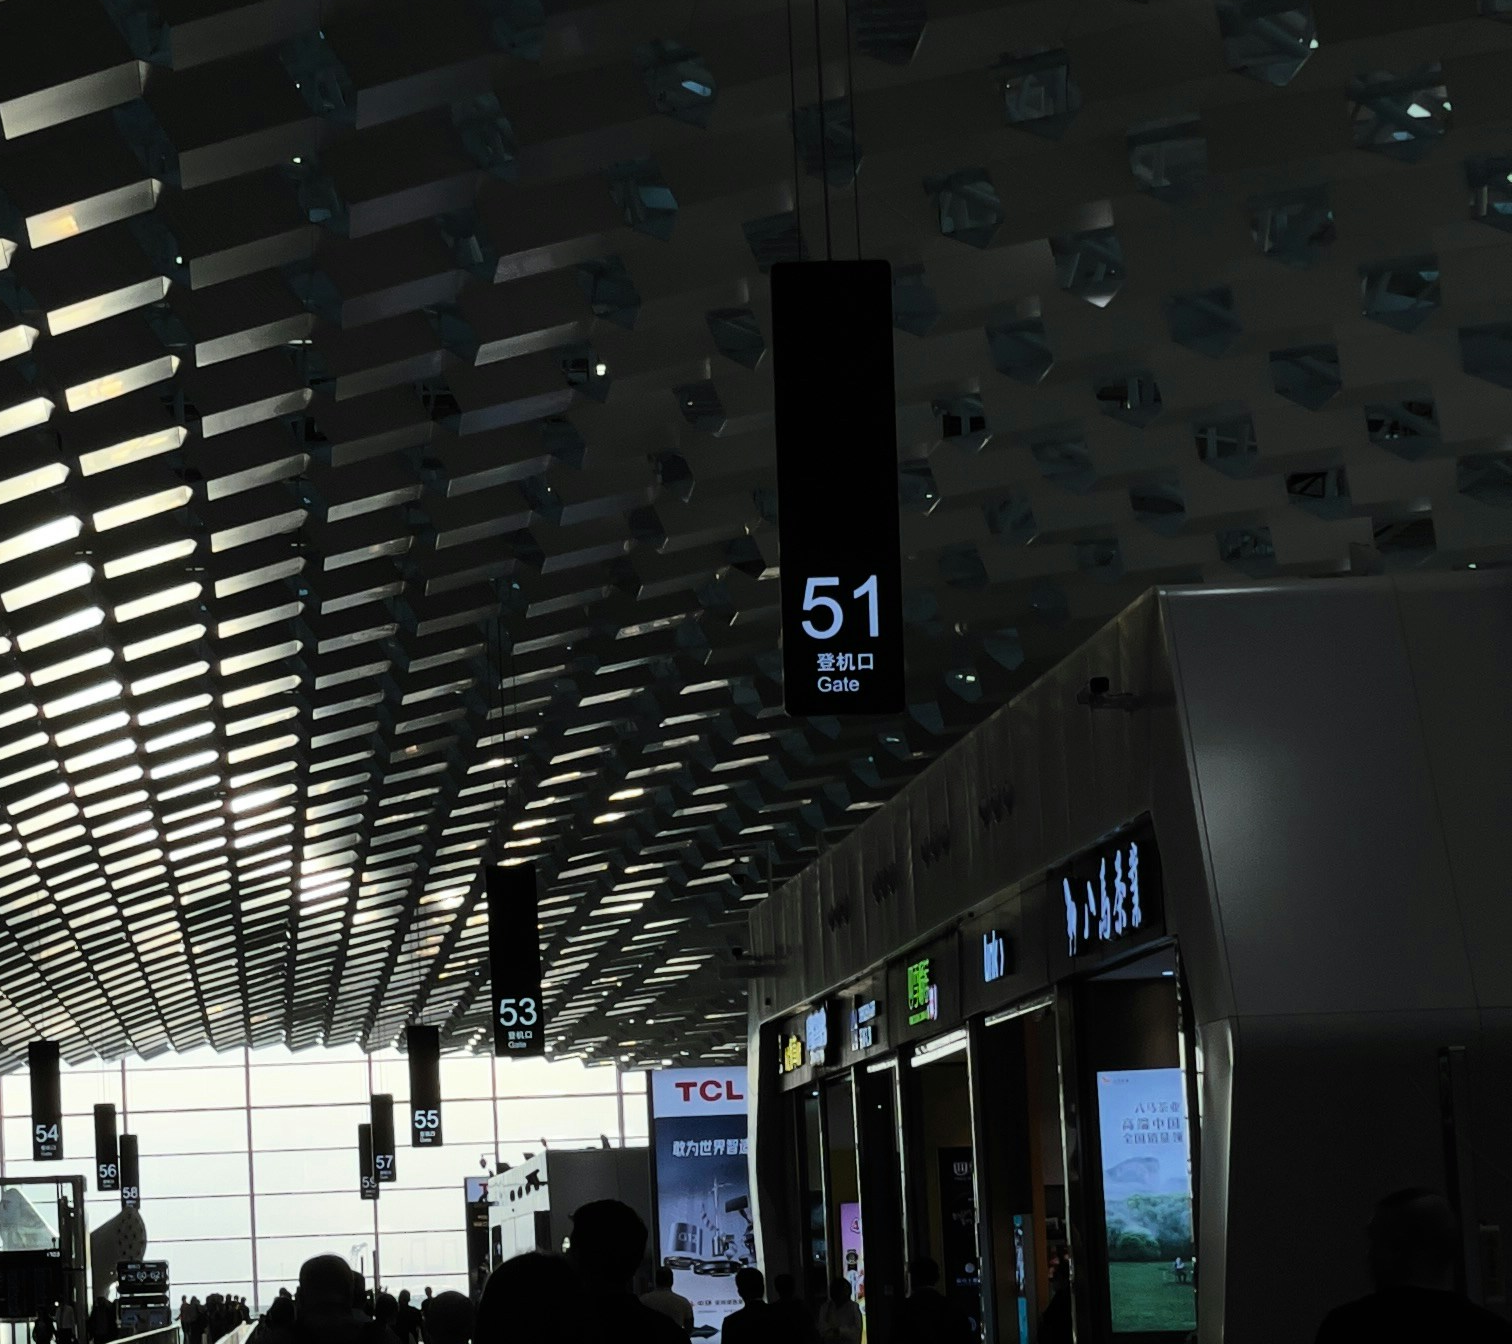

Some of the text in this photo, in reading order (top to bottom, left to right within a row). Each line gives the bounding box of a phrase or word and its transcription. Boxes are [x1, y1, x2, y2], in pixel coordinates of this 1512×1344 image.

[801, 574, 880, 640] 51
[817, 652, 875, 672] 登机口
[817, 676, 860, 694] Gate
[499, 997, 538, 1027] 53
[507, 1030, 533, 1040] 登机口
[675, 1080, 744, 1101] TCL
[414, 1109, 439, 1129] 55
[35, 1123, 59, 1143] 54
[99, 1163, 117, 1178] 56
[375, 1154, 394, 1170] 57
[122, 1186, 138, 1199] 58
